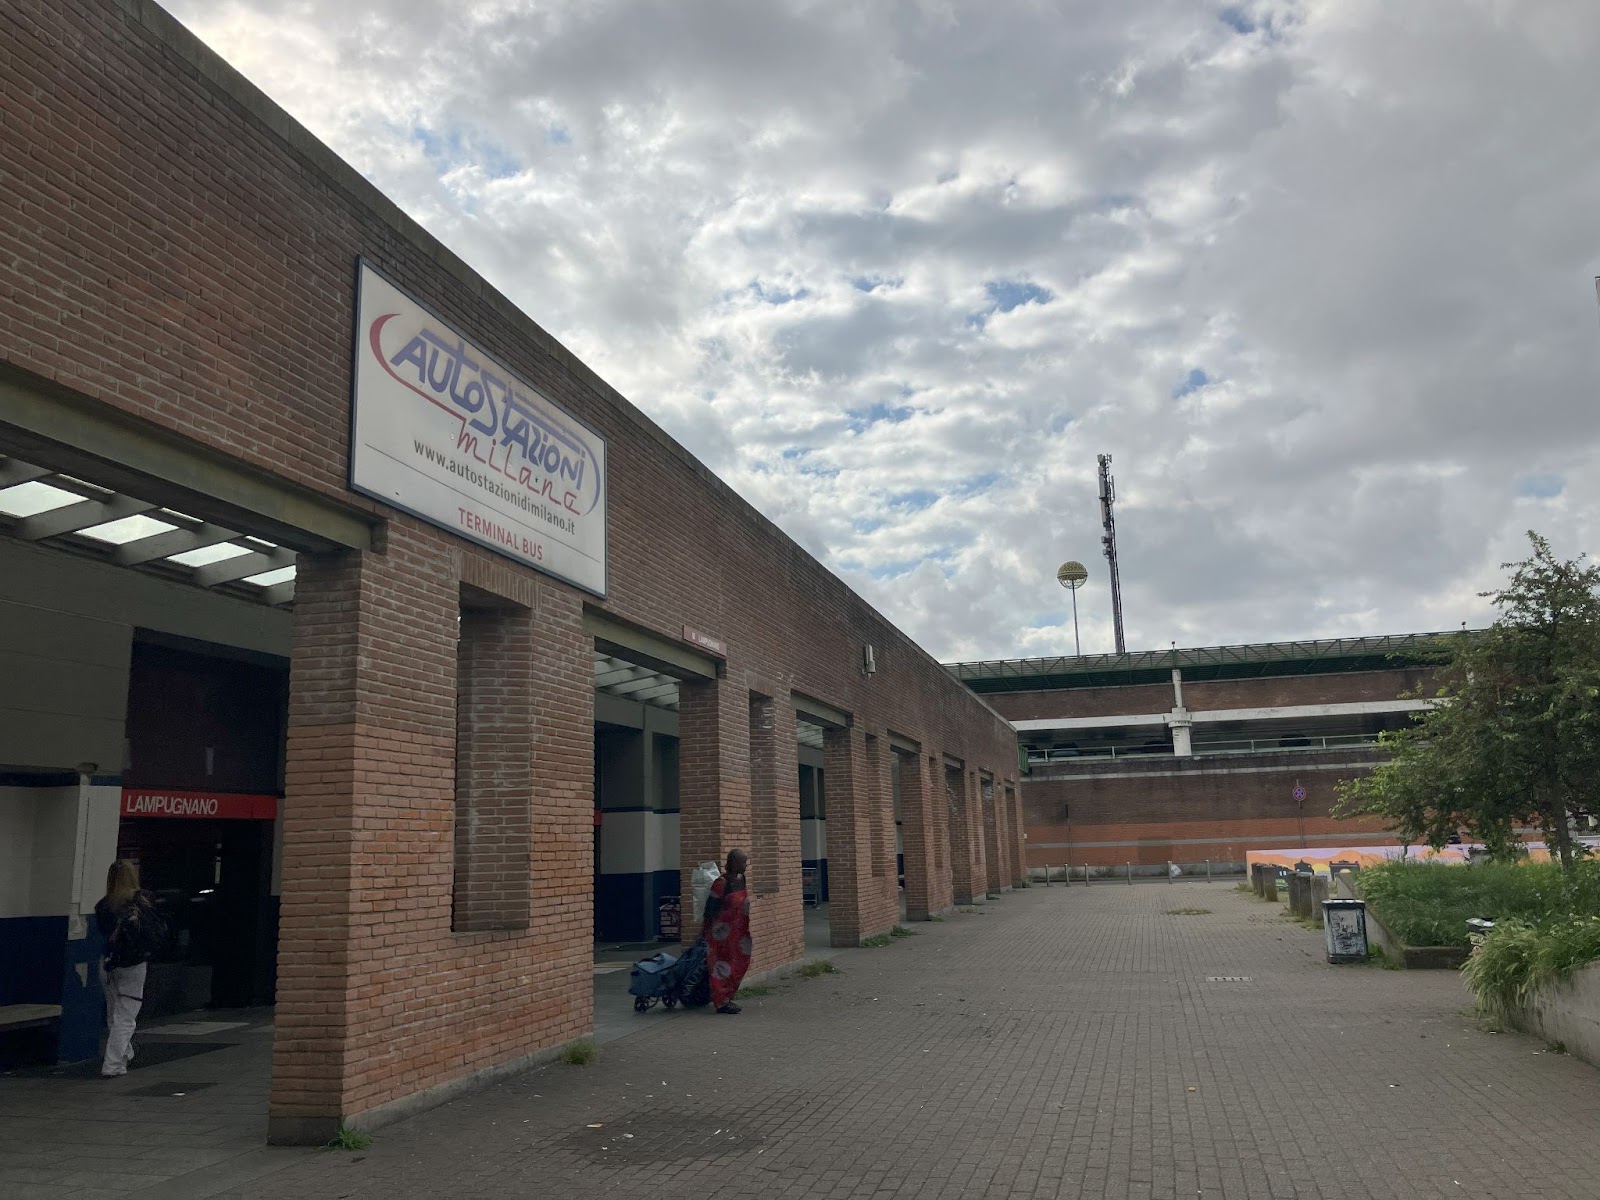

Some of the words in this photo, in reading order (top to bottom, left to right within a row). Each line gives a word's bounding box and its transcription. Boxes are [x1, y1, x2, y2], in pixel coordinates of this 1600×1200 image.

[414, 440, 575, 535] www.autostazionidimilano.it
[458, 507, 519, 550] TERMINAL
[522, 538, 543, 560] BUS
[126, 795, 218, 815] LAMPUGNANO
